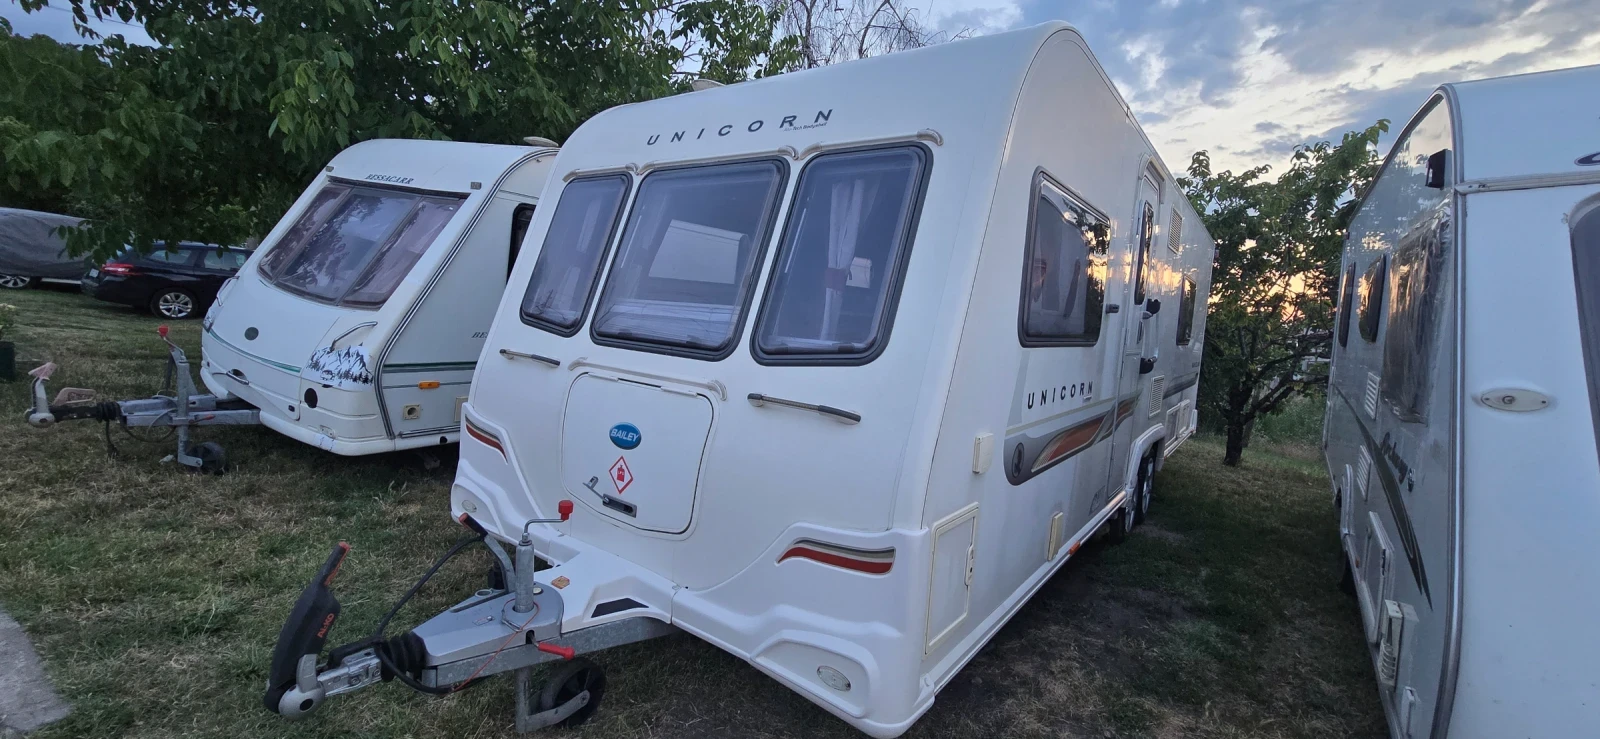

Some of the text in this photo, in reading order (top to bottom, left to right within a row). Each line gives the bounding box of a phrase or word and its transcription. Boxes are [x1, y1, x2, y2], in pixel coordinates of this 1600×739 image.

[647, 109, 832, 145] UNICORN
[364, 173, 414, 184] BESSACARR
[1027, 381, 1093, 409] UNICORN
[611, 428, 639, 442] BAILEY
